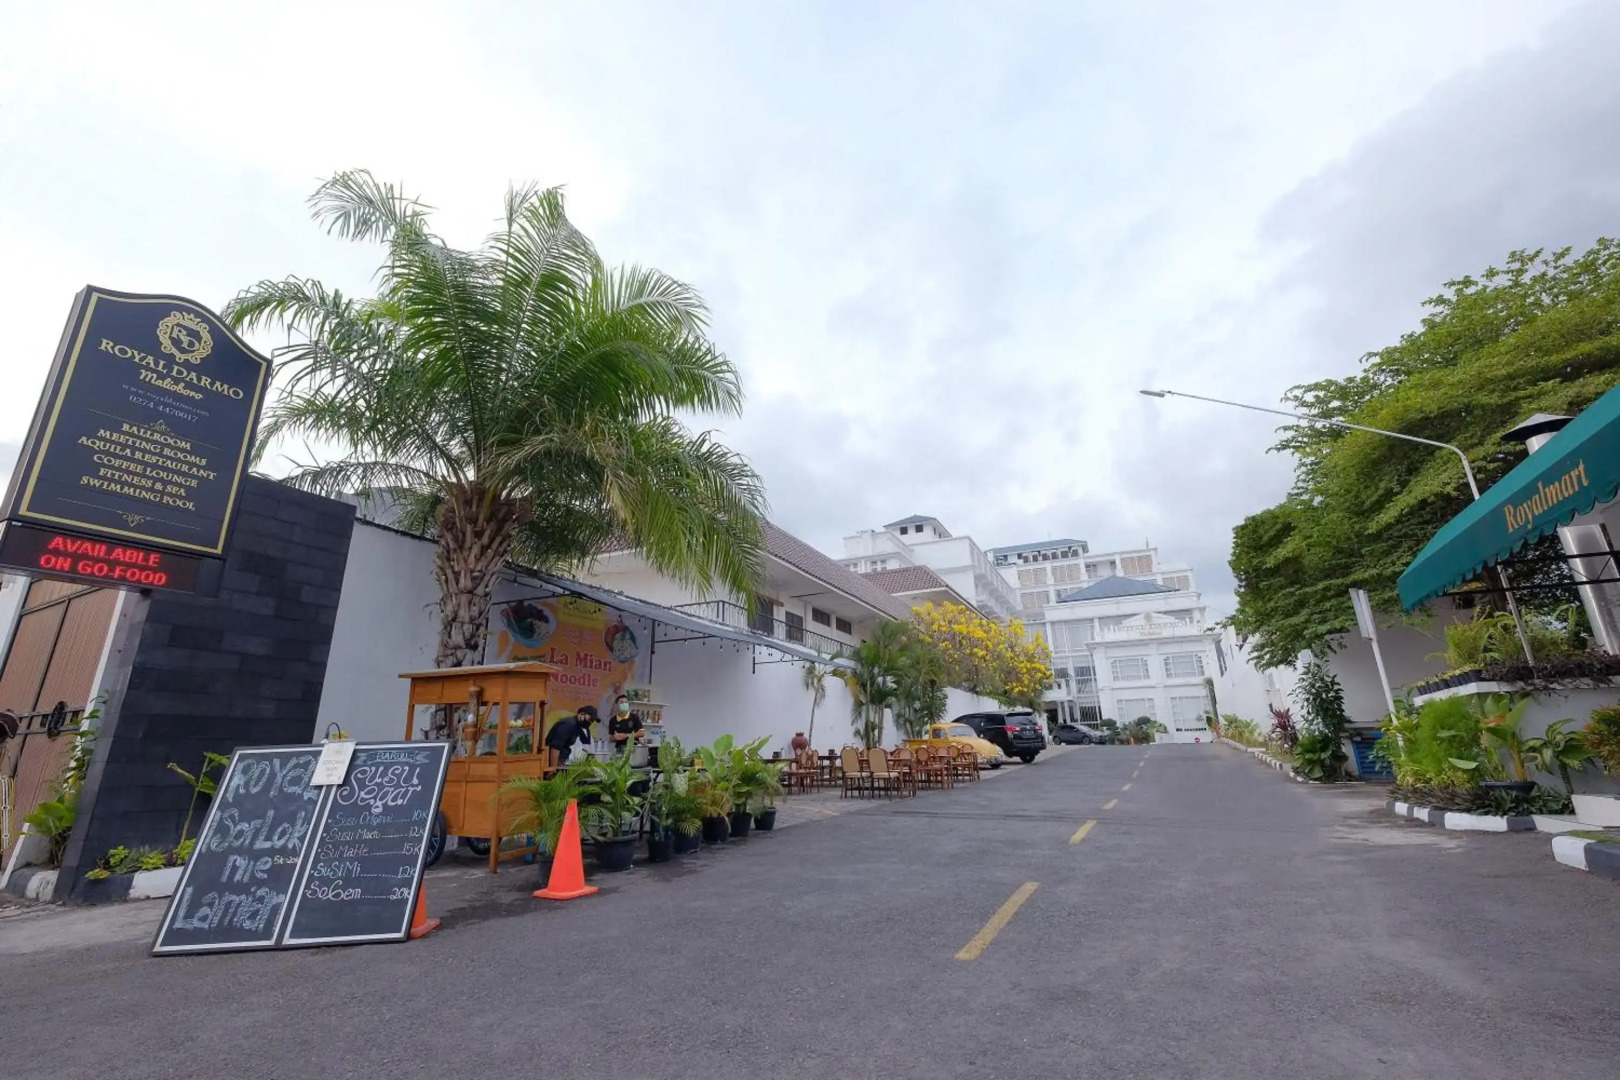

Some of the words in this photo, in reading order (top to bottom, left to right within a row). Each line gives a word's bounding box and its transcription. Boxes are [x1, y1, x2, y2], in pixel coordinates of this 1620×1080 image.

[98, 338, 168, 374] ROYAL
[171, 365, 244, 400] DARMO
[139, 369, 203, 400] Malioboro
[129, 395, 154, 409] 0274
[97, 429, 161, 453] MEETING
[162, 447, 208, 466] ROOMS
[121, 423, 191, 451] BALLROOM
[78, 436, 132, 457] AQUILA
[134, 451, 216, 480] RESTAURANT
[93, 454, 144, 473] COFFEE
[146, 467, 198, 488] LOUNGE
[80, 475, 161, 502] SWIMMING
[162, 495, 196, 511] POOL
[99, 467, 154, 488] FITNESS
[154, 482, 164, 491] &
[165, 484, 186, 496] SPA
[1503, 458, 1589, 533] Royalmart
[48, 535, 162, 568] AVAILABLE
[40, 554, 73, 571] ON
[77, 560, 168, 586] GO-FOOD
[548, 647, 569, 666] La
[575, 651, 613, 672] Mian
[547, 672, 599, 688] Noodle
